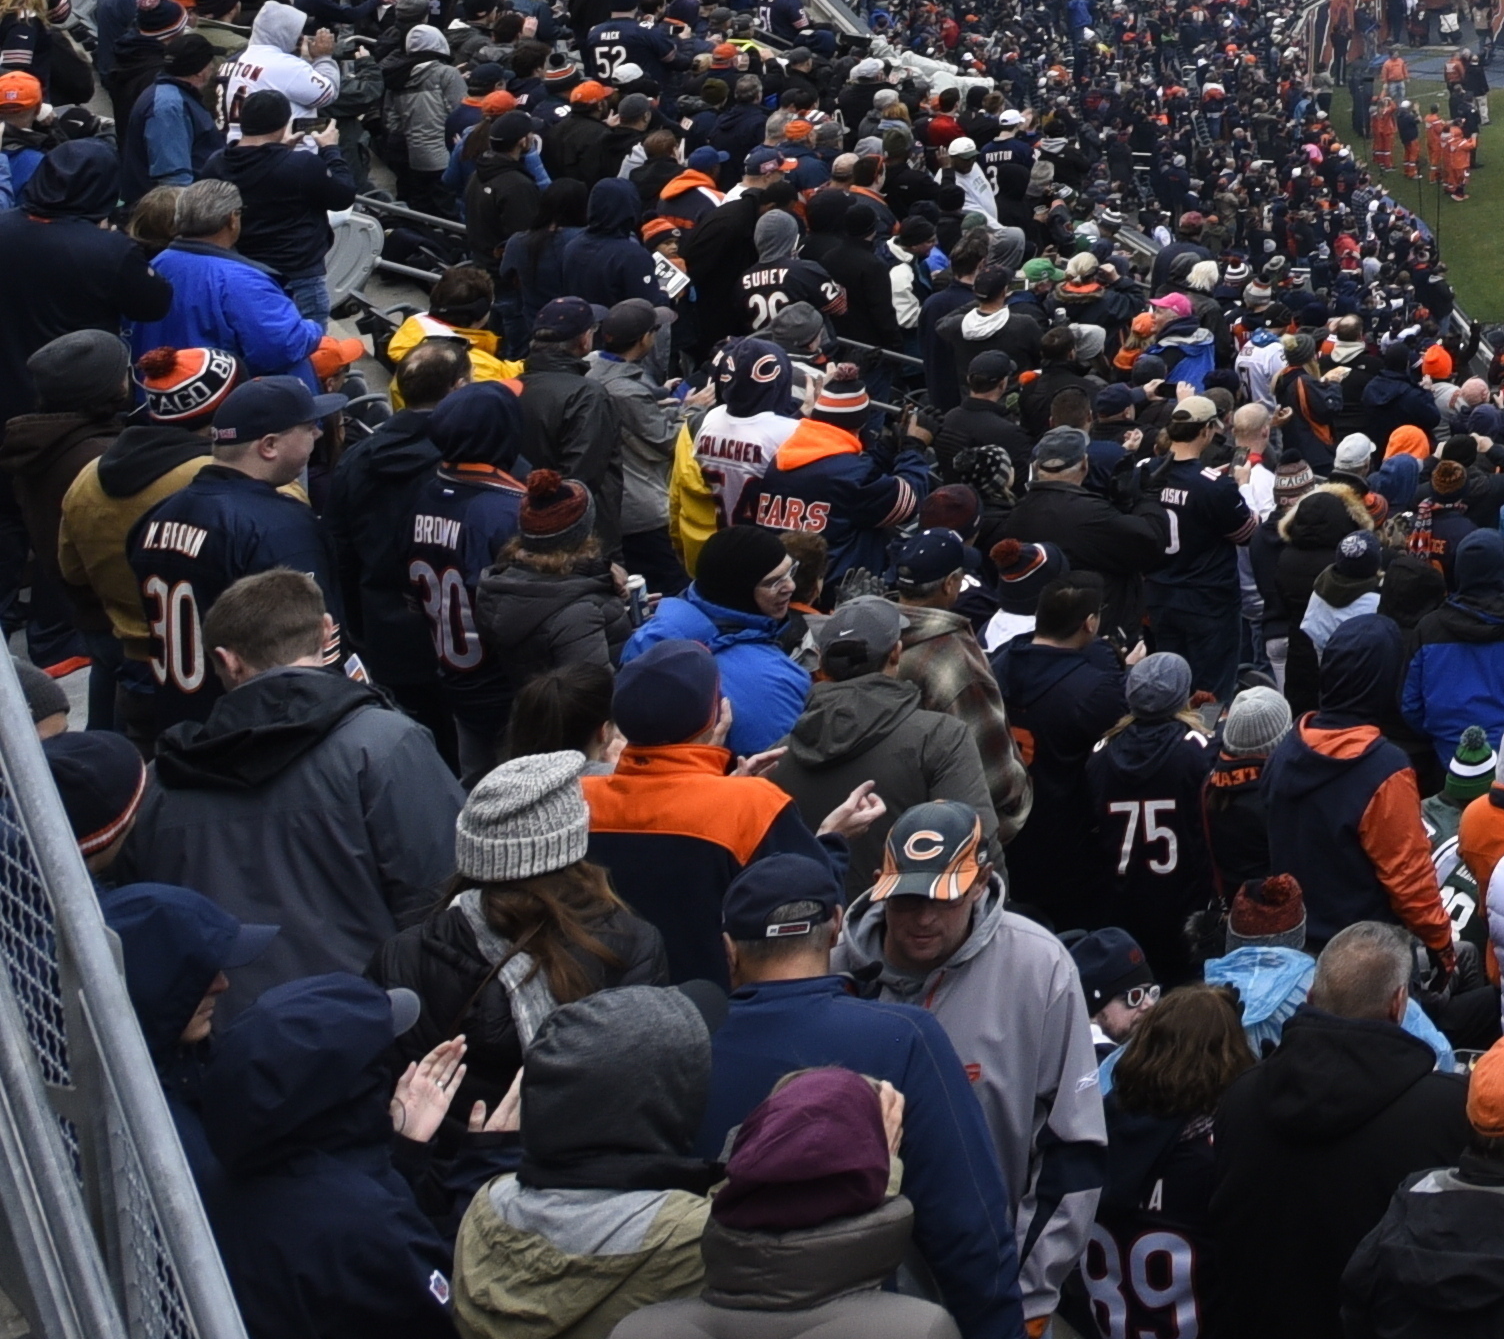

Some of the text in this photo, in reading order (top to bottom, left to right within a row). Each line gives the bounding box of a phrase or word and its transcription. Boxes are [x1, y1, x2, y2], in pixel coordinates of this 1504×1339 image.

[594, 44, 627, 79] 52
[742, 267, 789, 290] SUHEY
[413, 513, 462, 552] BROWN
[143, 575, 205, 693] 30
[408, 558, 483, 670] 30
[1109, 798, 1179, 876] 75
